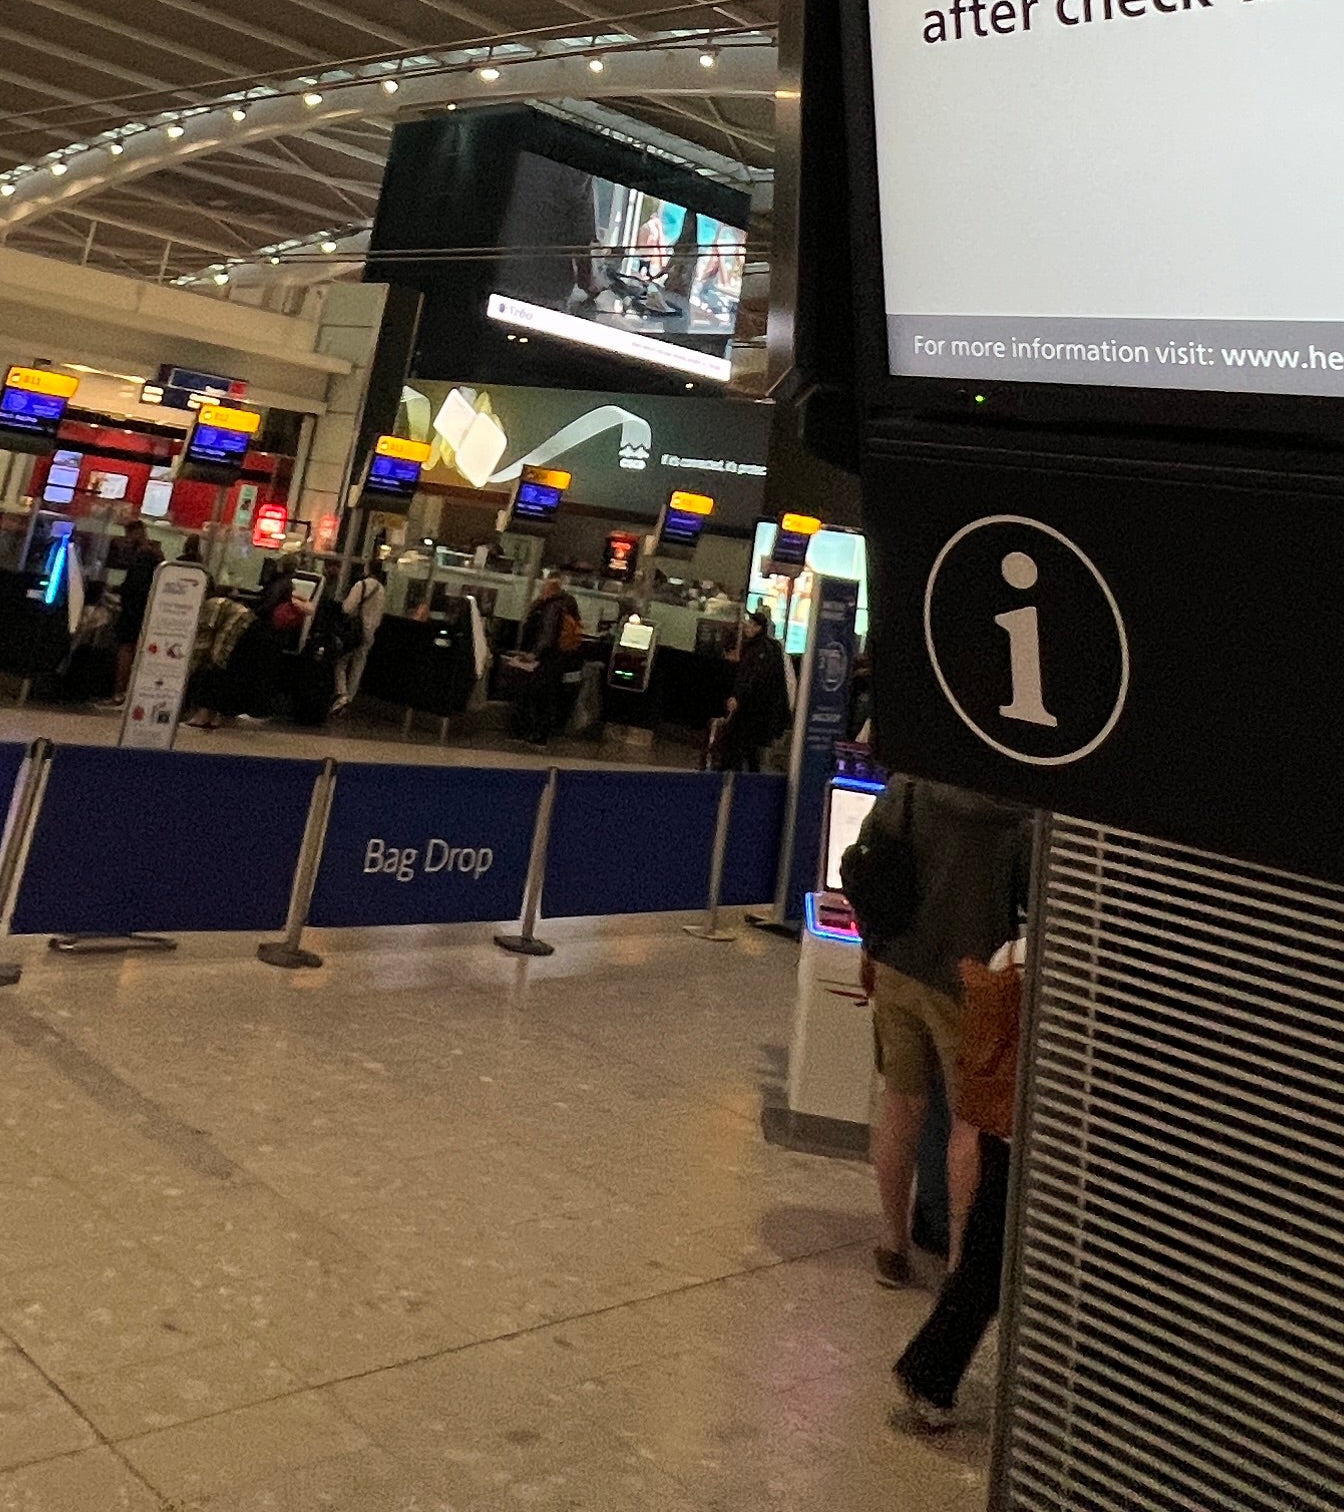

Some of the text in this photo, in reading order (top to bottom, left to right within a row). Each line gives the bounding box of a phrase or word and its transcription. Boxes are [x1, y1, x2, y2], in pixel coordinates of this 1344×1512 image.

[914, 335, 946, 356] For
[951, 340, 1006, 358] more
[1012, 337, 1149, 364] information
[1155, 341, 1215, 367] visit:
[363, 838, 493, 882] Bag Drop
